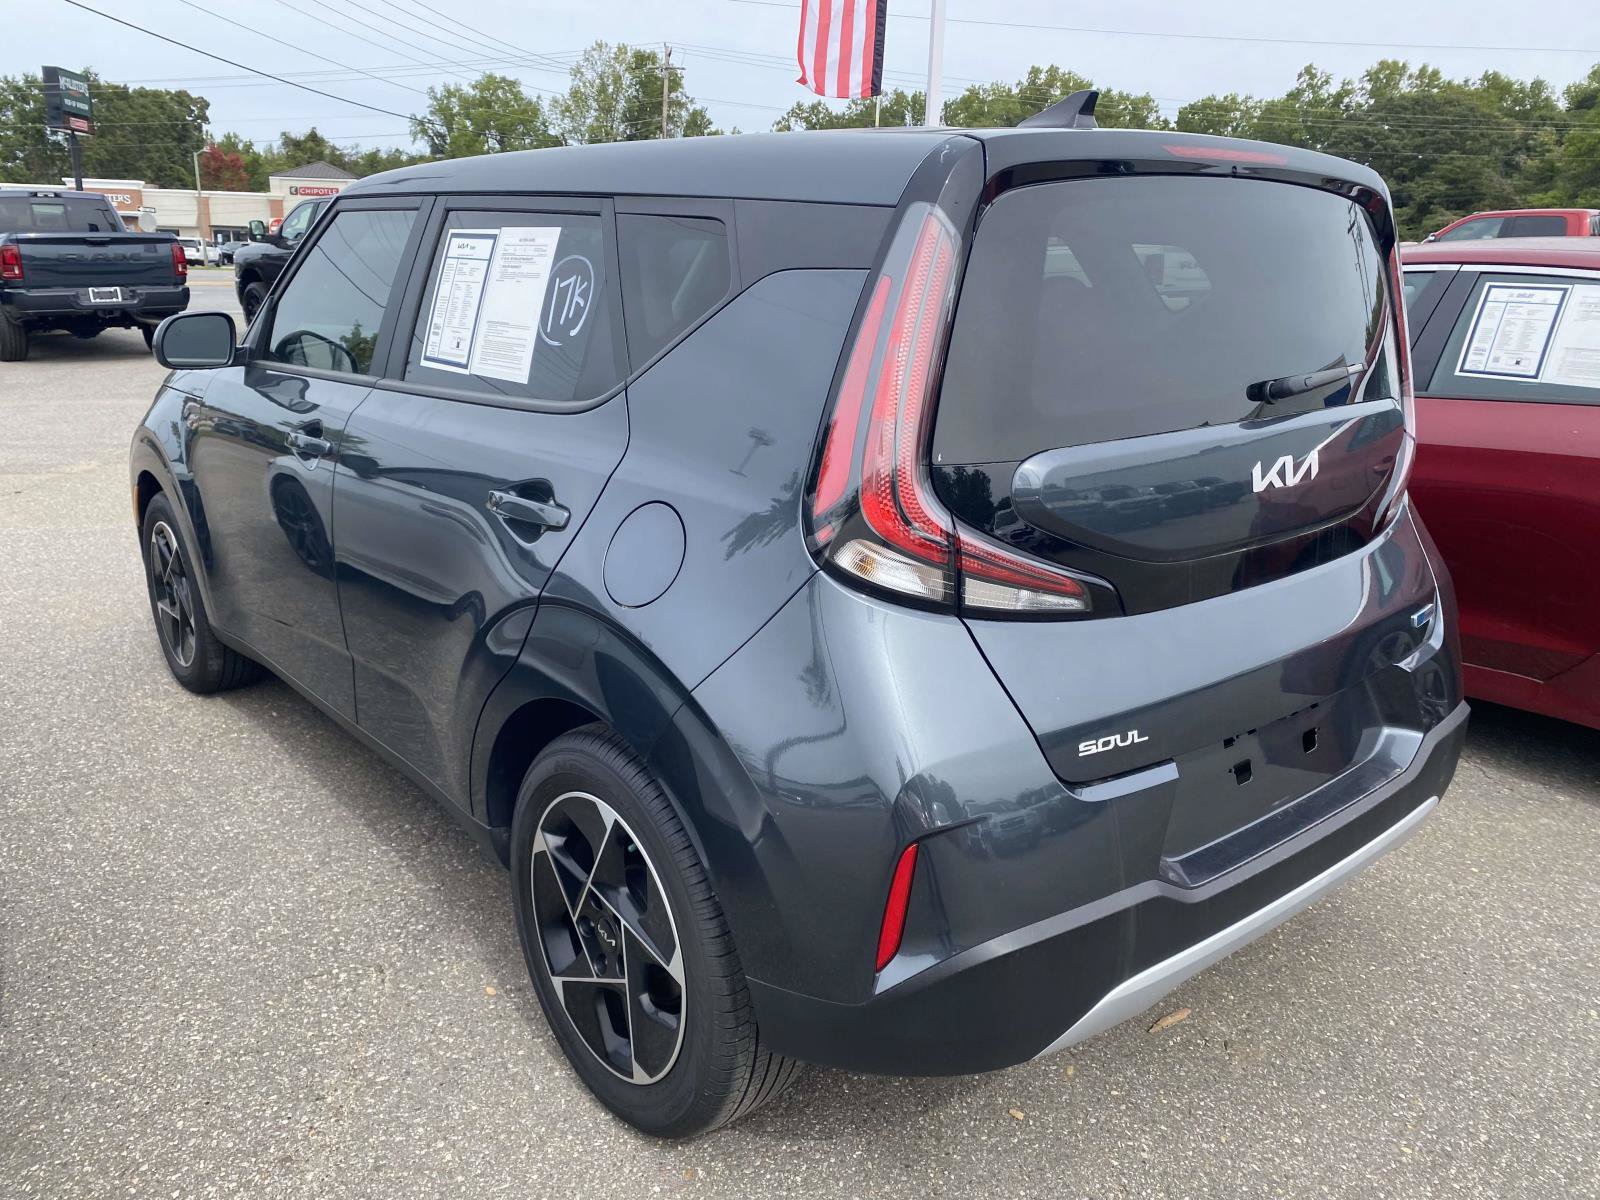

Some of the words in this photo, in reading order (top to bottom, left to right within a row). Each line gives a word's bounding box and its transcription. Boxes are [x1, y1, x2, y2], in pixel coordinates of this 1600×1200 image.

[547, 275, 587, 333] 17K
[1252, 450, 1319, 493] KIA
[1078, 729, 1149, 757] SOUL
